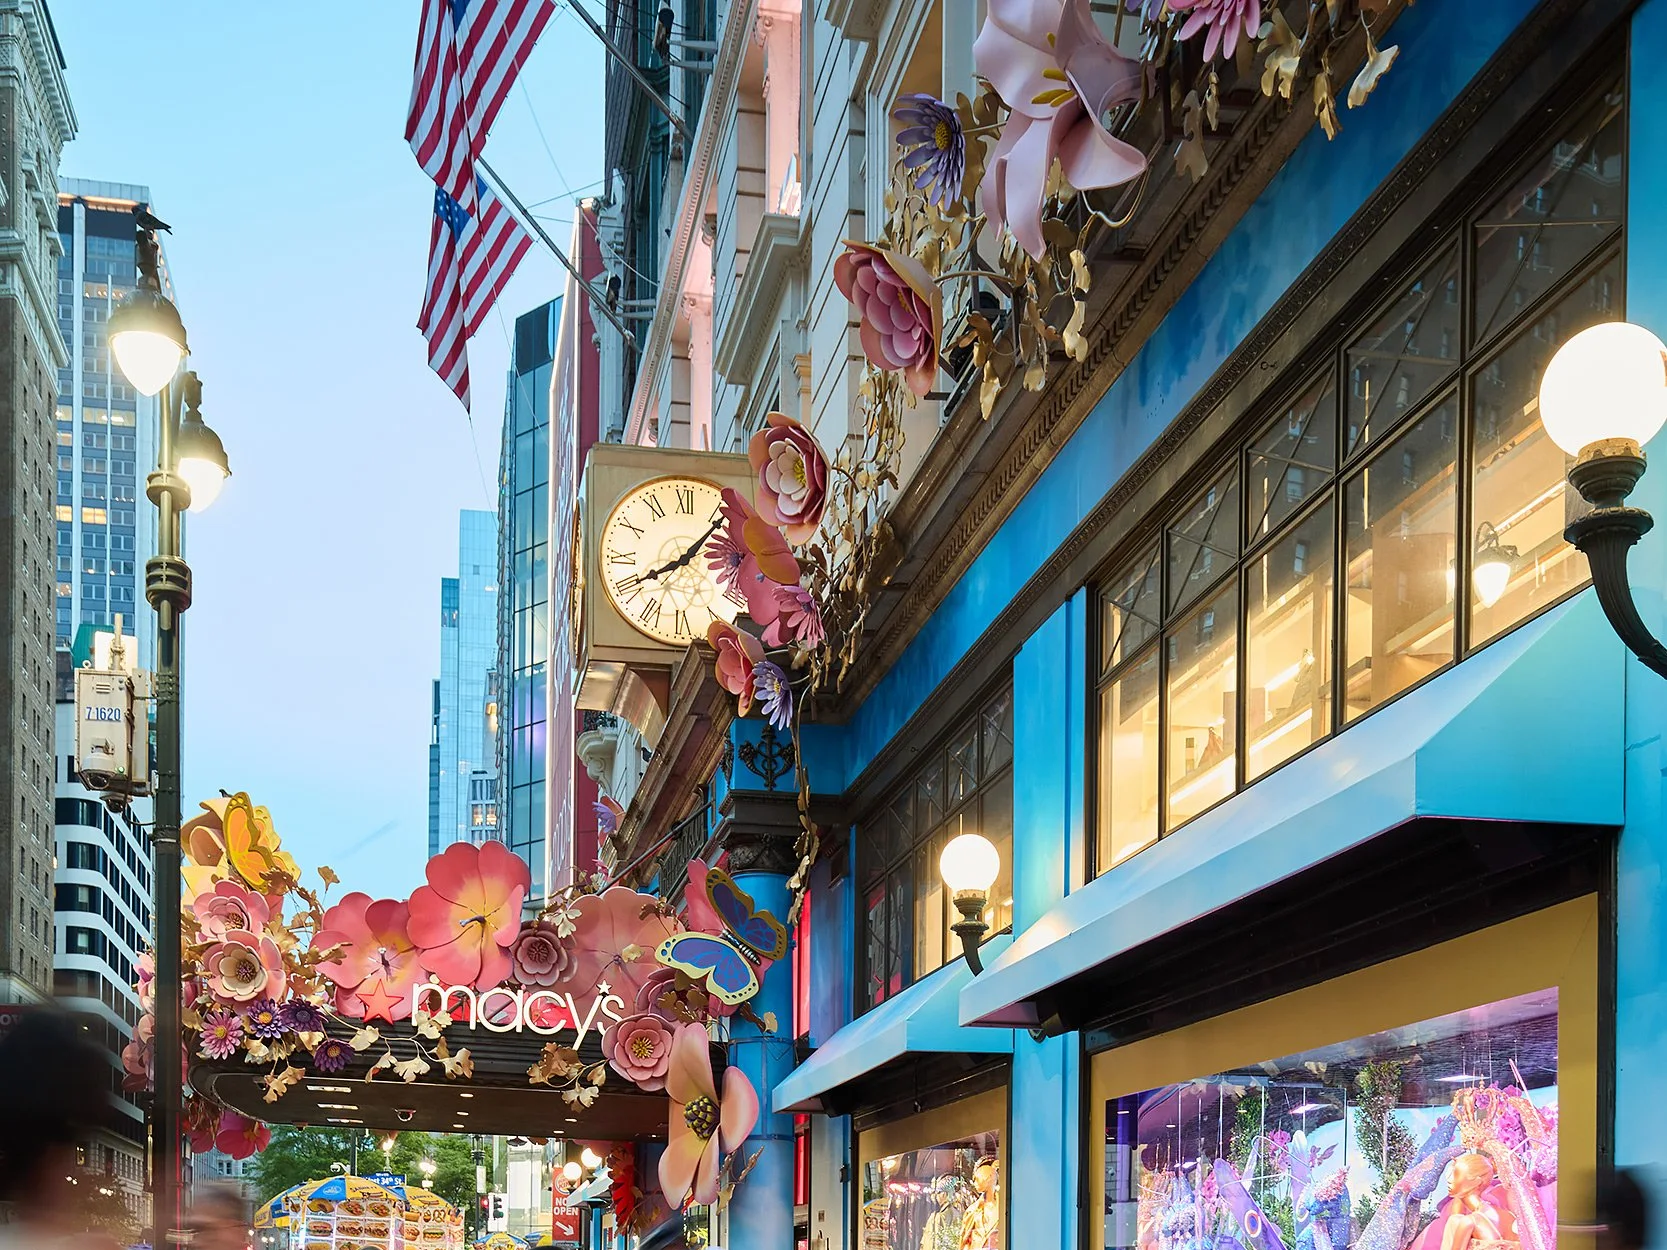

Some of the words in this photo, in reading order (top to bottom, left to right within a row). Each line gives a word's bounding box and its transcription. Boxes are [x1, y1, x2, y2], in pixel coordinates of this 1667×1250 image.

[643, 494, 666, 522] XI
[675, 489, 694, 515] XII
[619, 516, 645, 539] X
[553, 1206, 579, 1216] OPEN
[555, 1197, 567, 1207] NO
